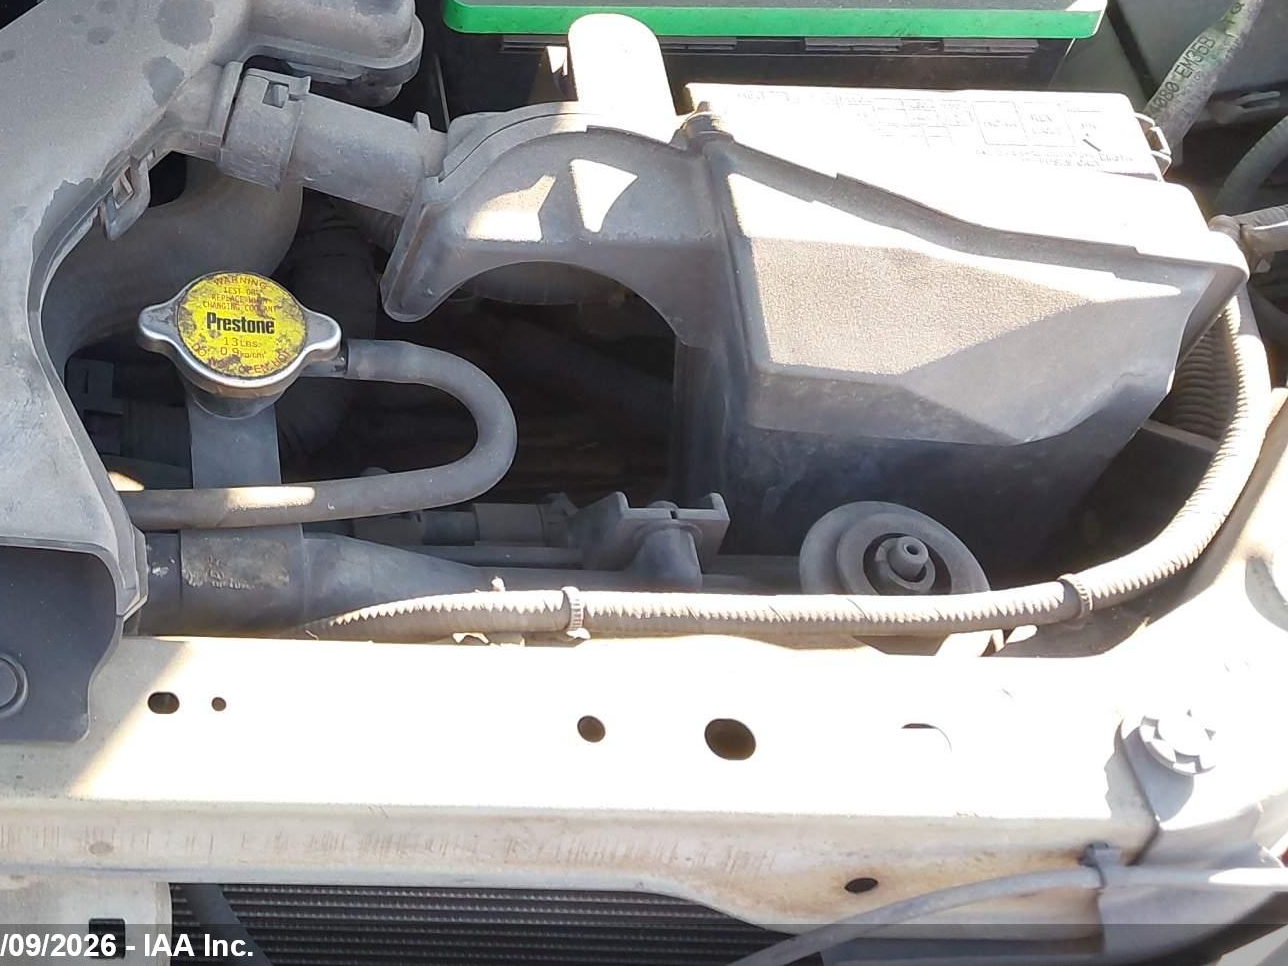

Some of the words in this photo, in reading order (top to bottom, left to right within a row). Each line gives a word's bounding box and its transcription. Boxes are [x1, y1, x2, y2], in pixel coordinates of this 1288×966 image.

[1174, 35, 1216, 79] EM35B
[215, 276, 267, 289] WARNING
[212, 294, 244, 304] REPLACE
[203, 301, 240, 312] CHANGING
[207, 312, 276, 334] Prestone
